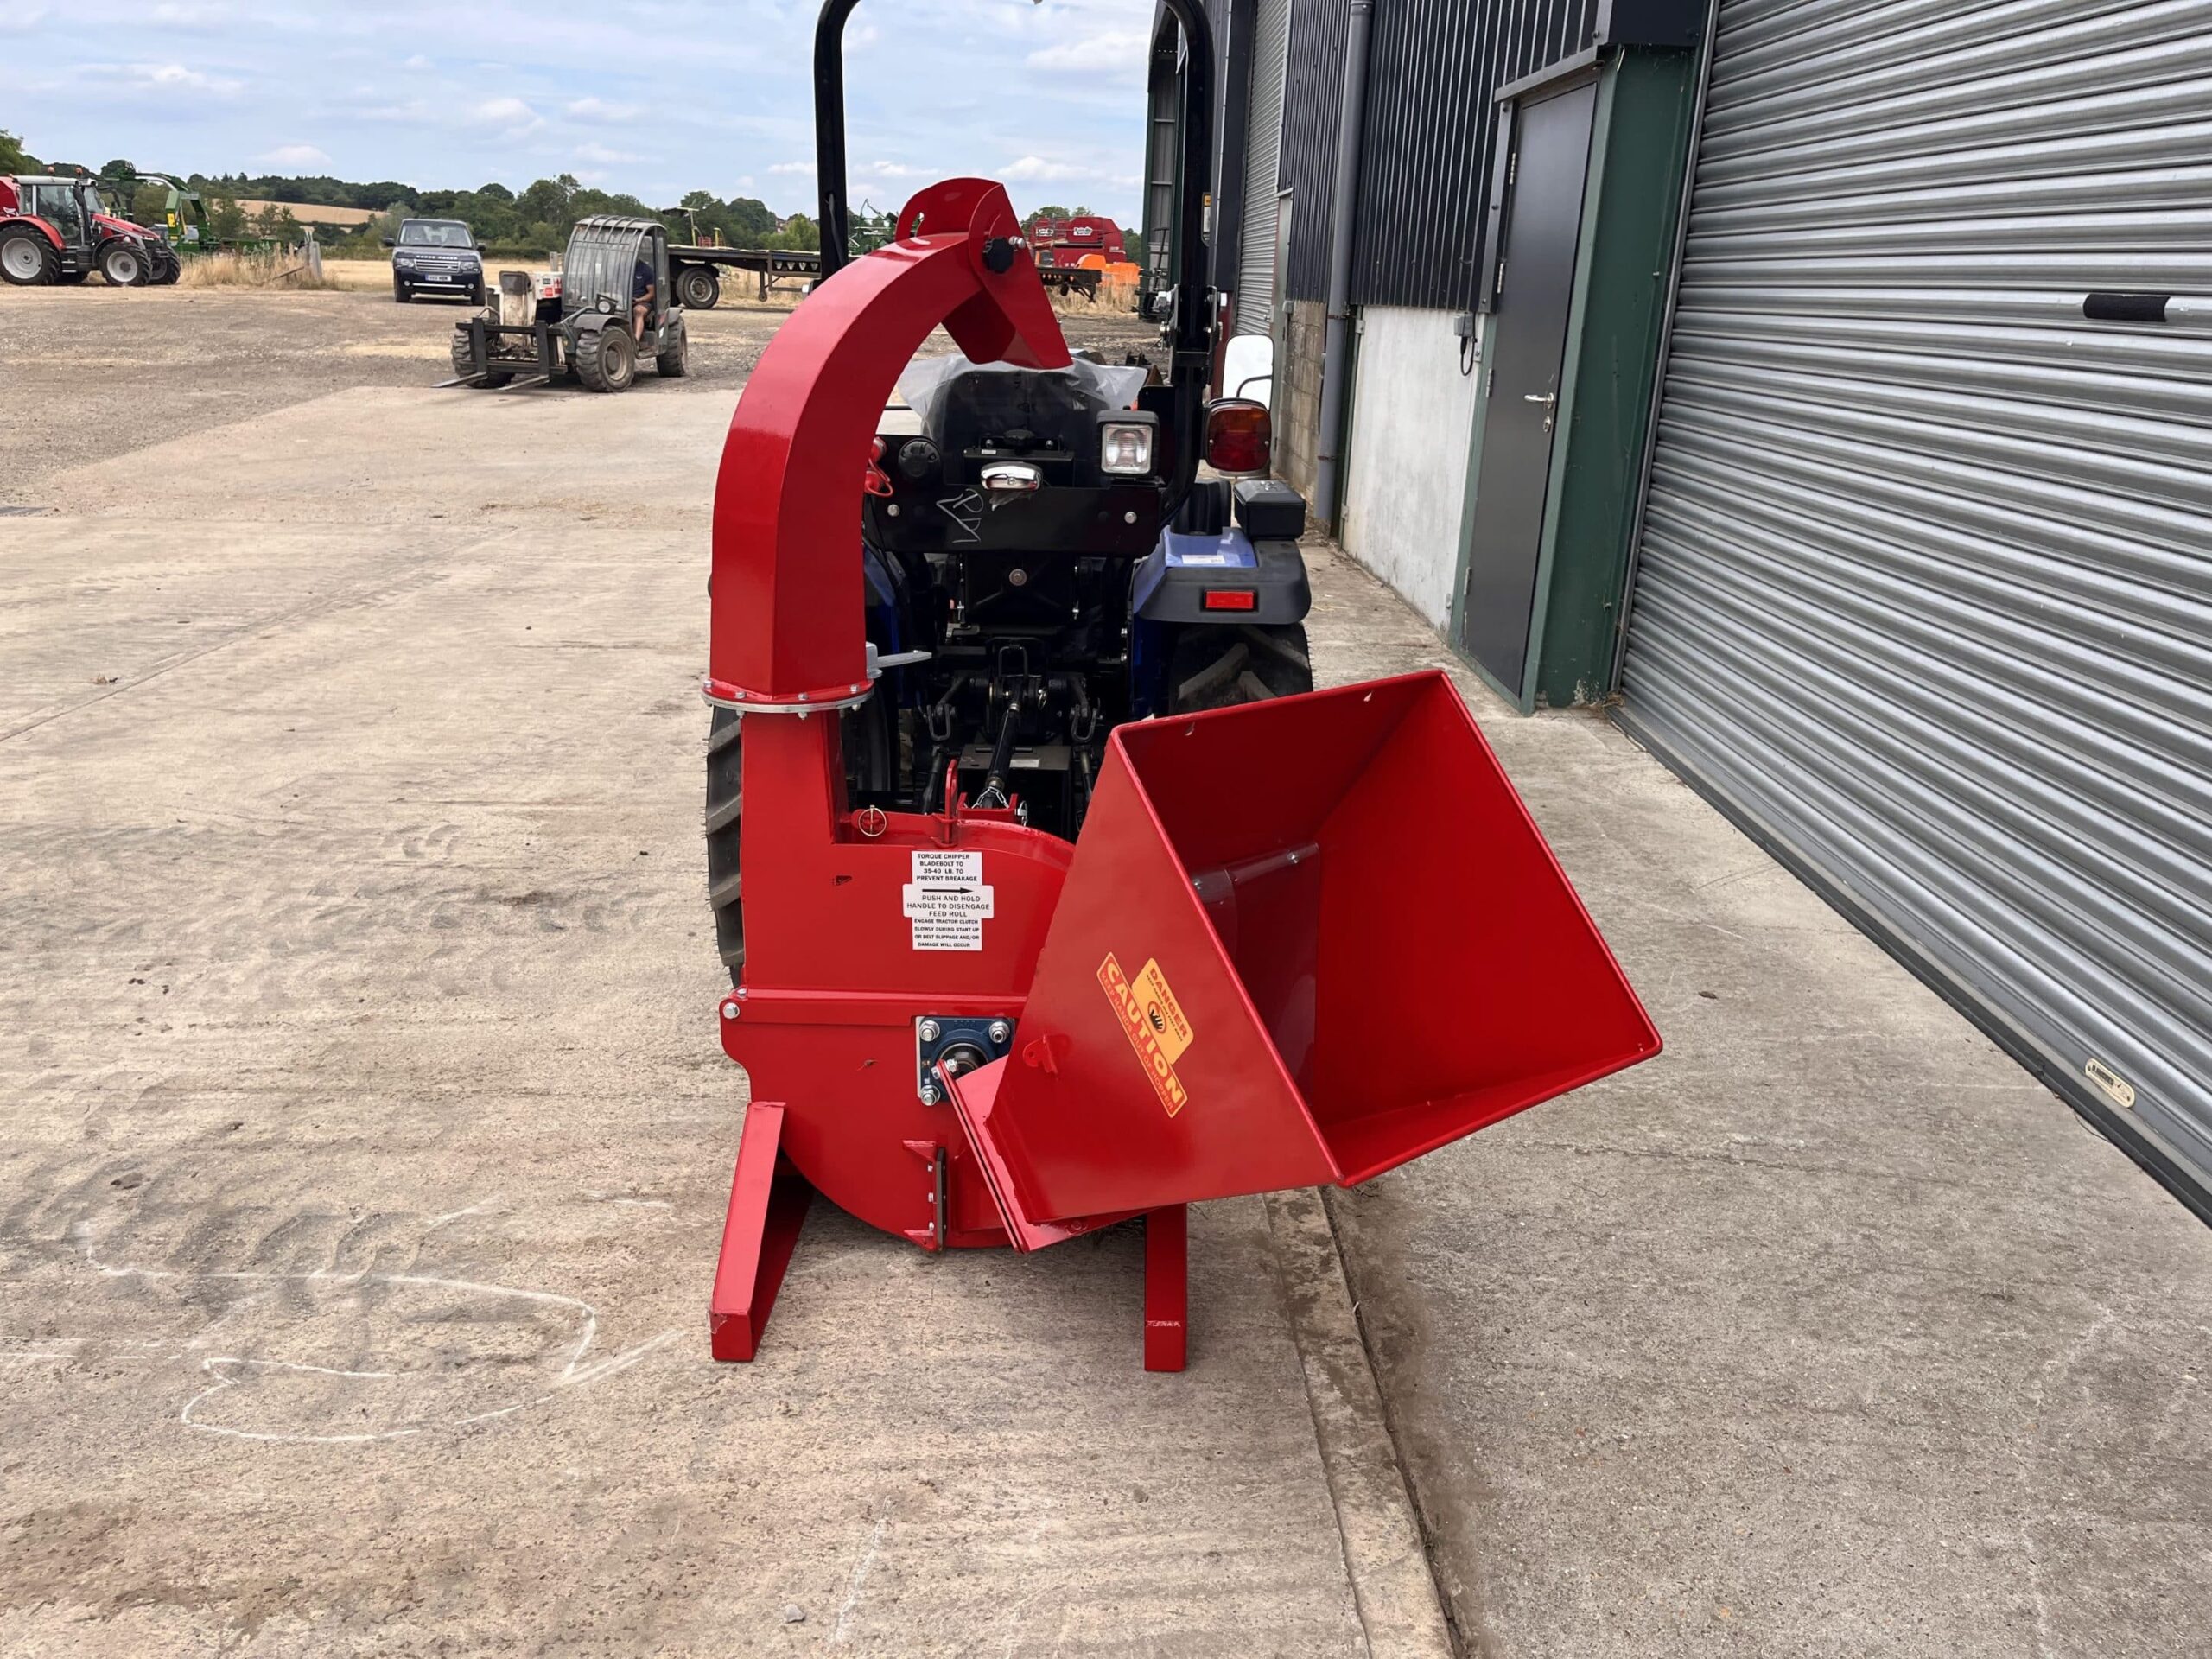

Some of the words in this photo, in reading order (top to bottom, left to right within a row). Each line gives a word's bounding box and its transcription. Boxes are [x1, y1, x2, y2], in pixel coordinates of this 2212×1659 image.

[1101, 971, 1116, 996] KEEP
[1113, 995, 1133, 1033] HANDS
[1132, 1033, 1144, 1053] OUT
[1143, 1054, 1153, 1070] OF
[1151, 1069, 1174, 1110] HOPPER
[1107, 962, 1183, 1103] CAUTION
[1150, 967, 1187, 1037] DANGER
